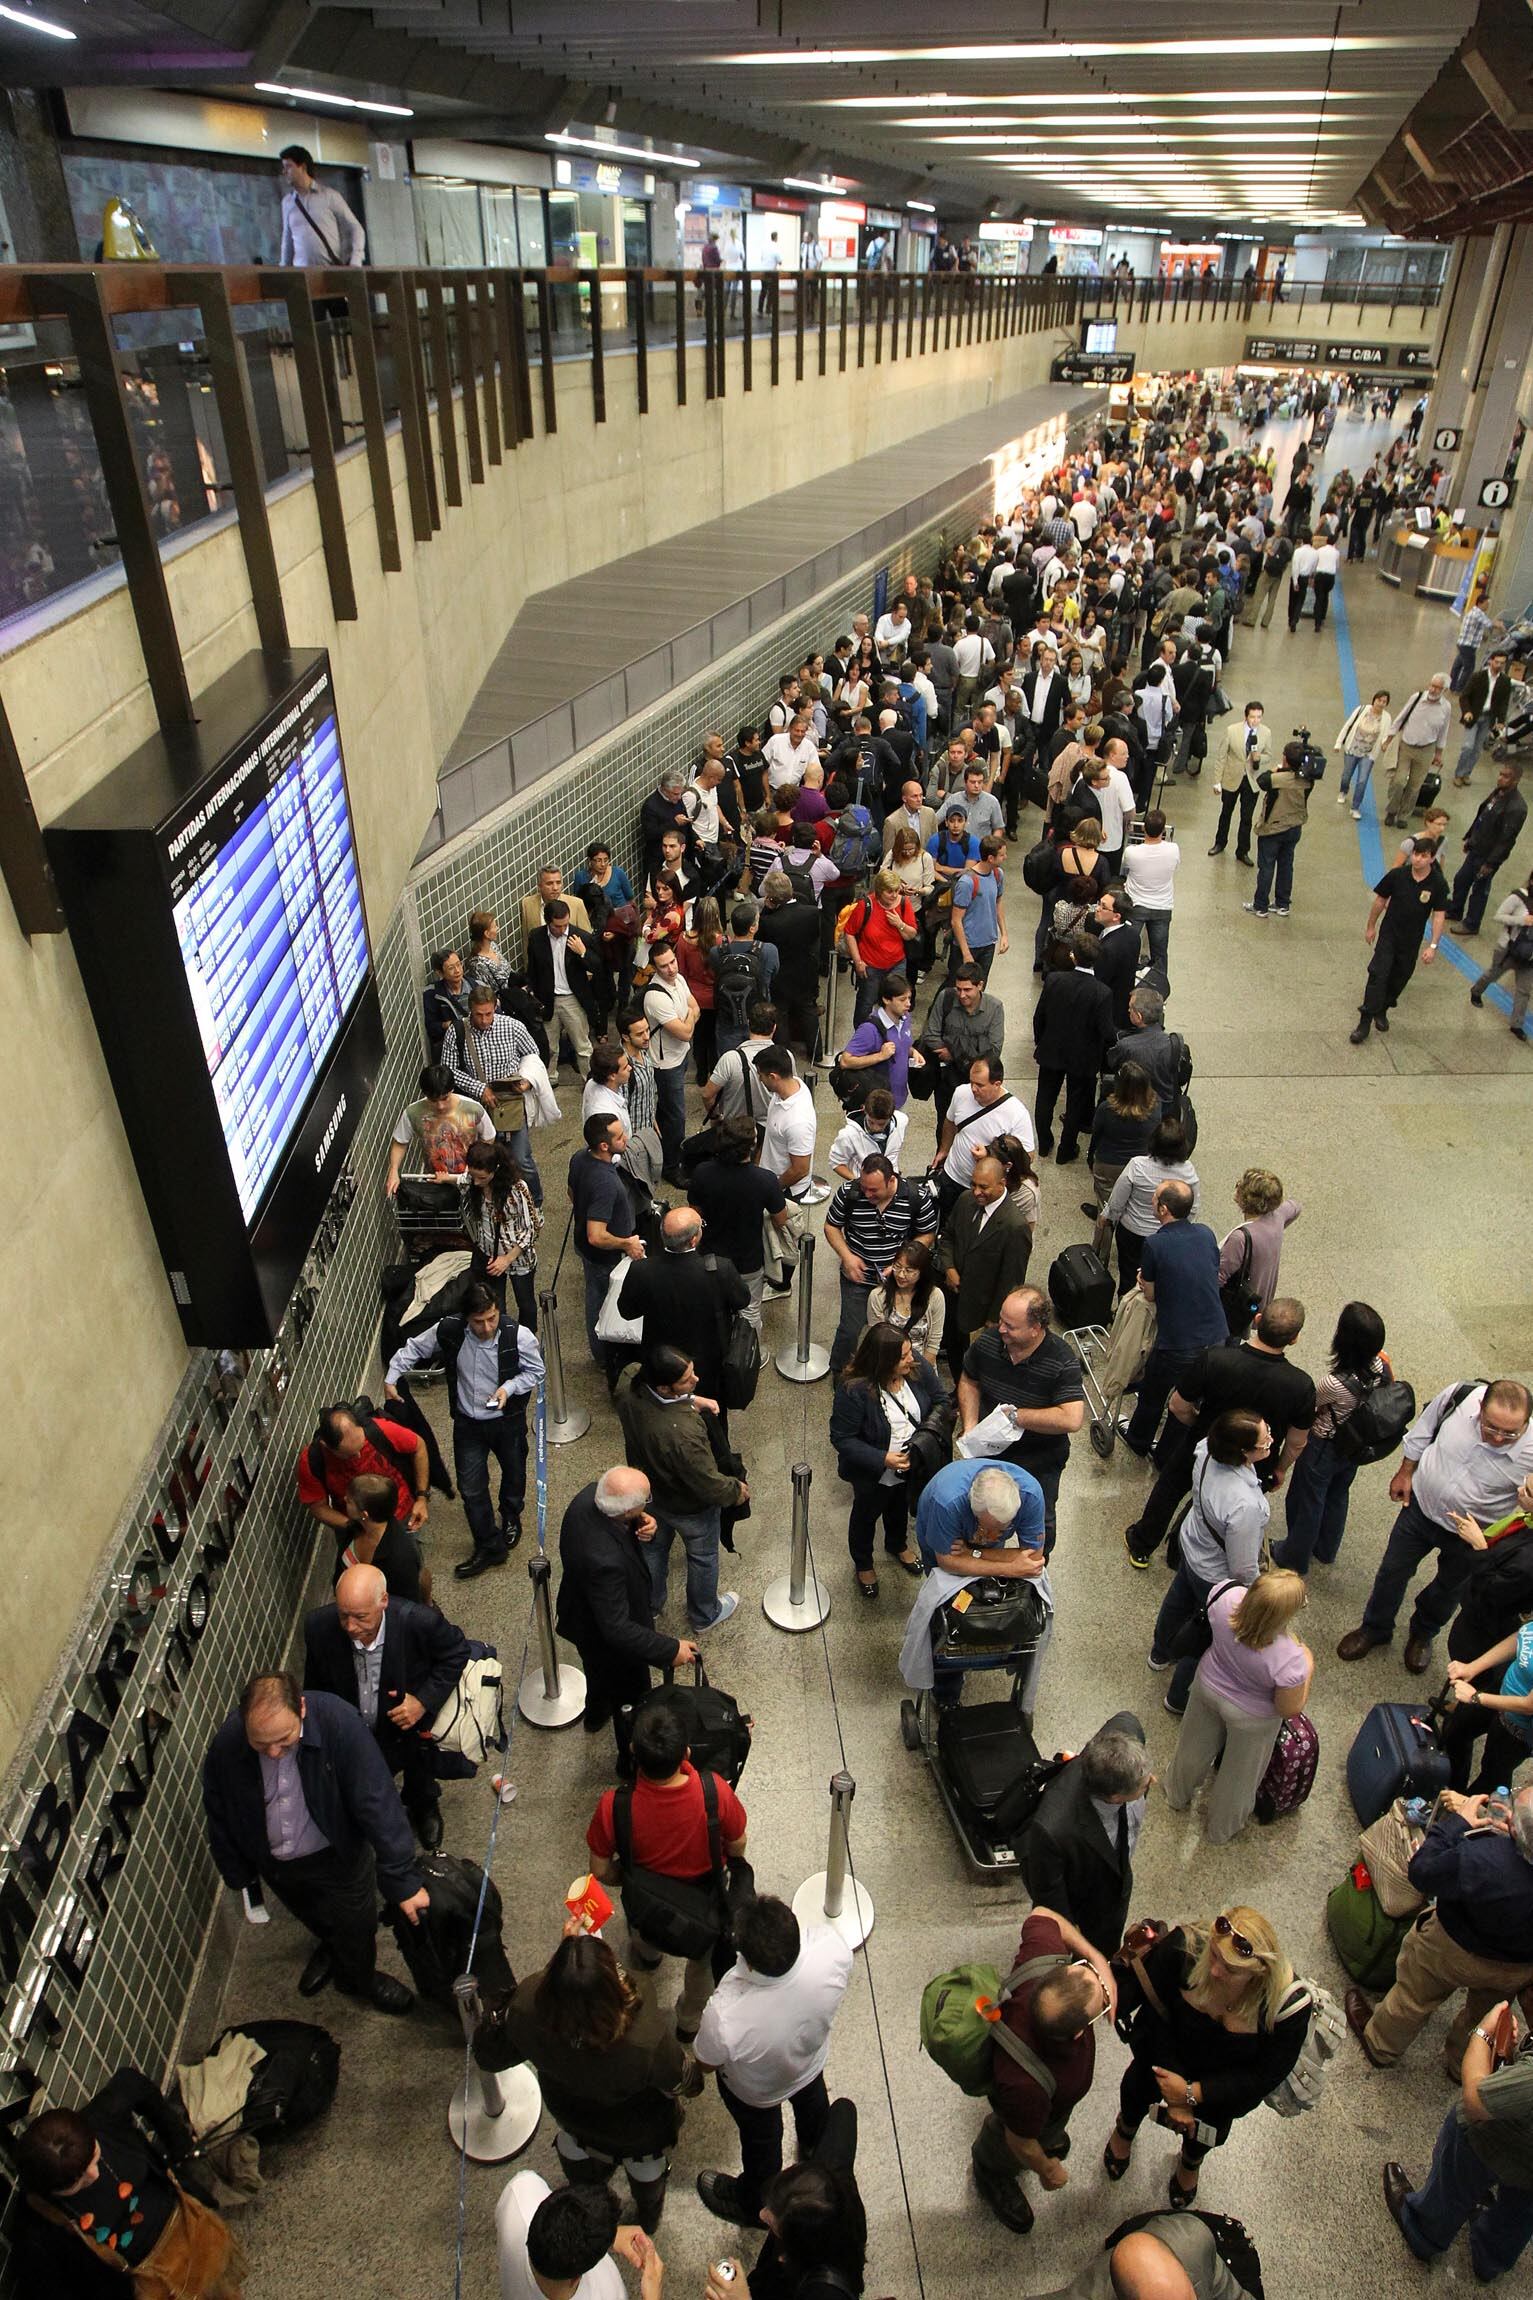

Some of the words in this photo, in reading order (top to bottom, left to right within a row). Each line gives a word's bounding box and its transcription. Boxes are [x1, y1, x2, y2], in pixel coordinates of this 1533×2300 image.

[168, 809, 206, 861] PARTIDAS
[205, 750, 258, 819] INTERNACIONAIS
[260, 702, 300, 757] INTERNATIONAL
[299, 672, 327, 713] DEPARTURES
[315, 1093, 347, 1173] SAMSUNG
